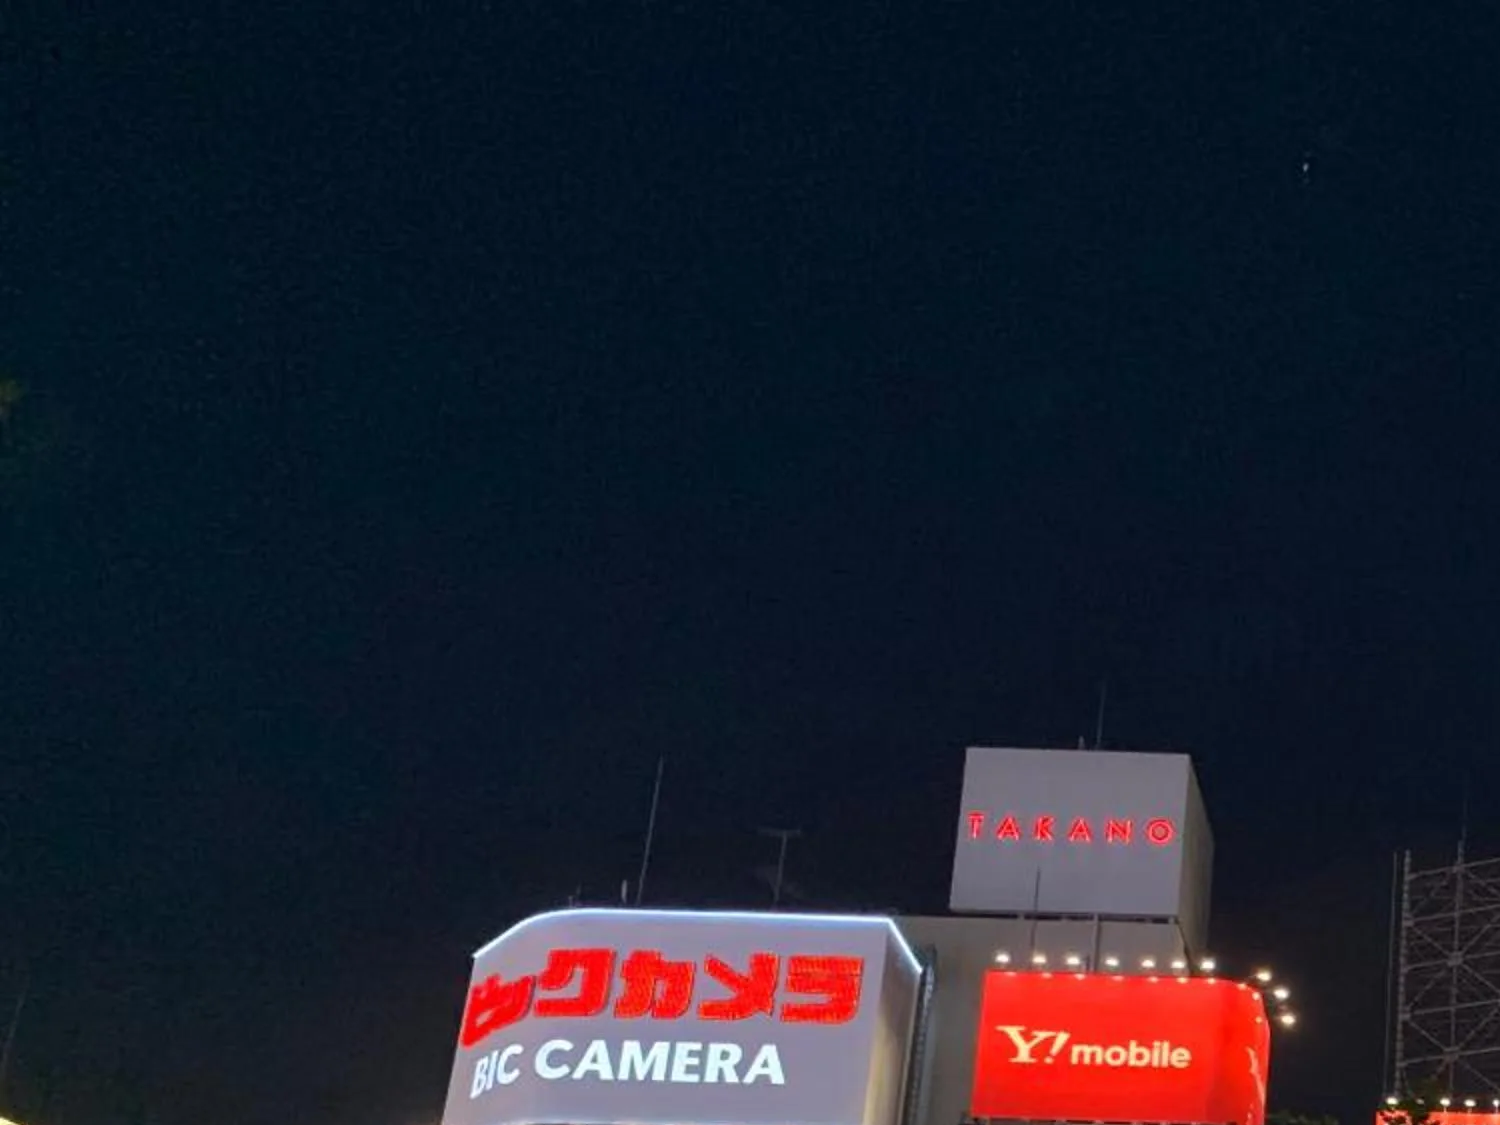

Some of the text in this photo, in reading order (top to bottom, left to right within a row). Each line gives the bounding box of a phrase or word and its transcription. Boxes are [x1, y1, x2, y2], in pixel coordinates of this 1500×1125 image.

[968, 812, 1175, 846] TAKANO
[470, 1039, 786, 1099] BIC CAMERA
